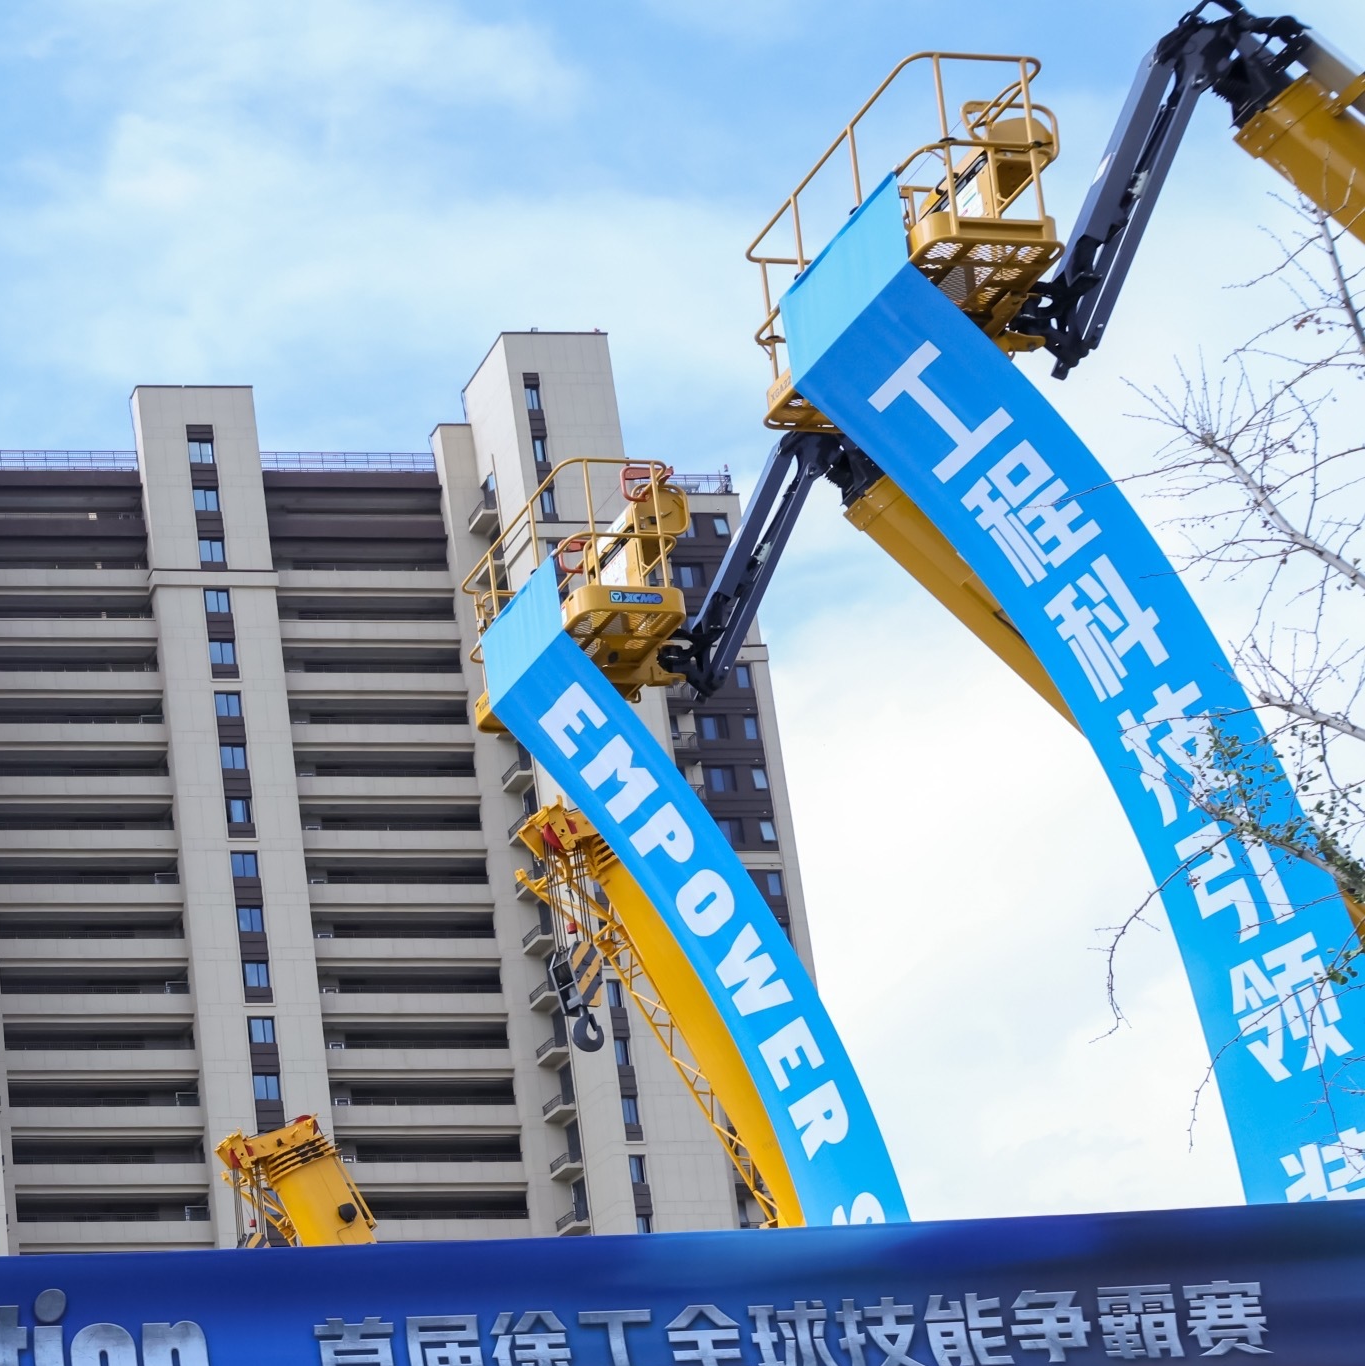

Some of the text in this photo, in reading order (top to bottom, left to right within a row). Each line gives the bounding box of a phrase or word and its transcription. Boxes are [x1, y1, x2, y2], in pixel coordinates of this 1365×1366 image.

[624, 592, 663, 604] XCMG
[868, 340, 1353, 1082] 工程科技引领
[538, 681, 850, 1161] EMPOWER
